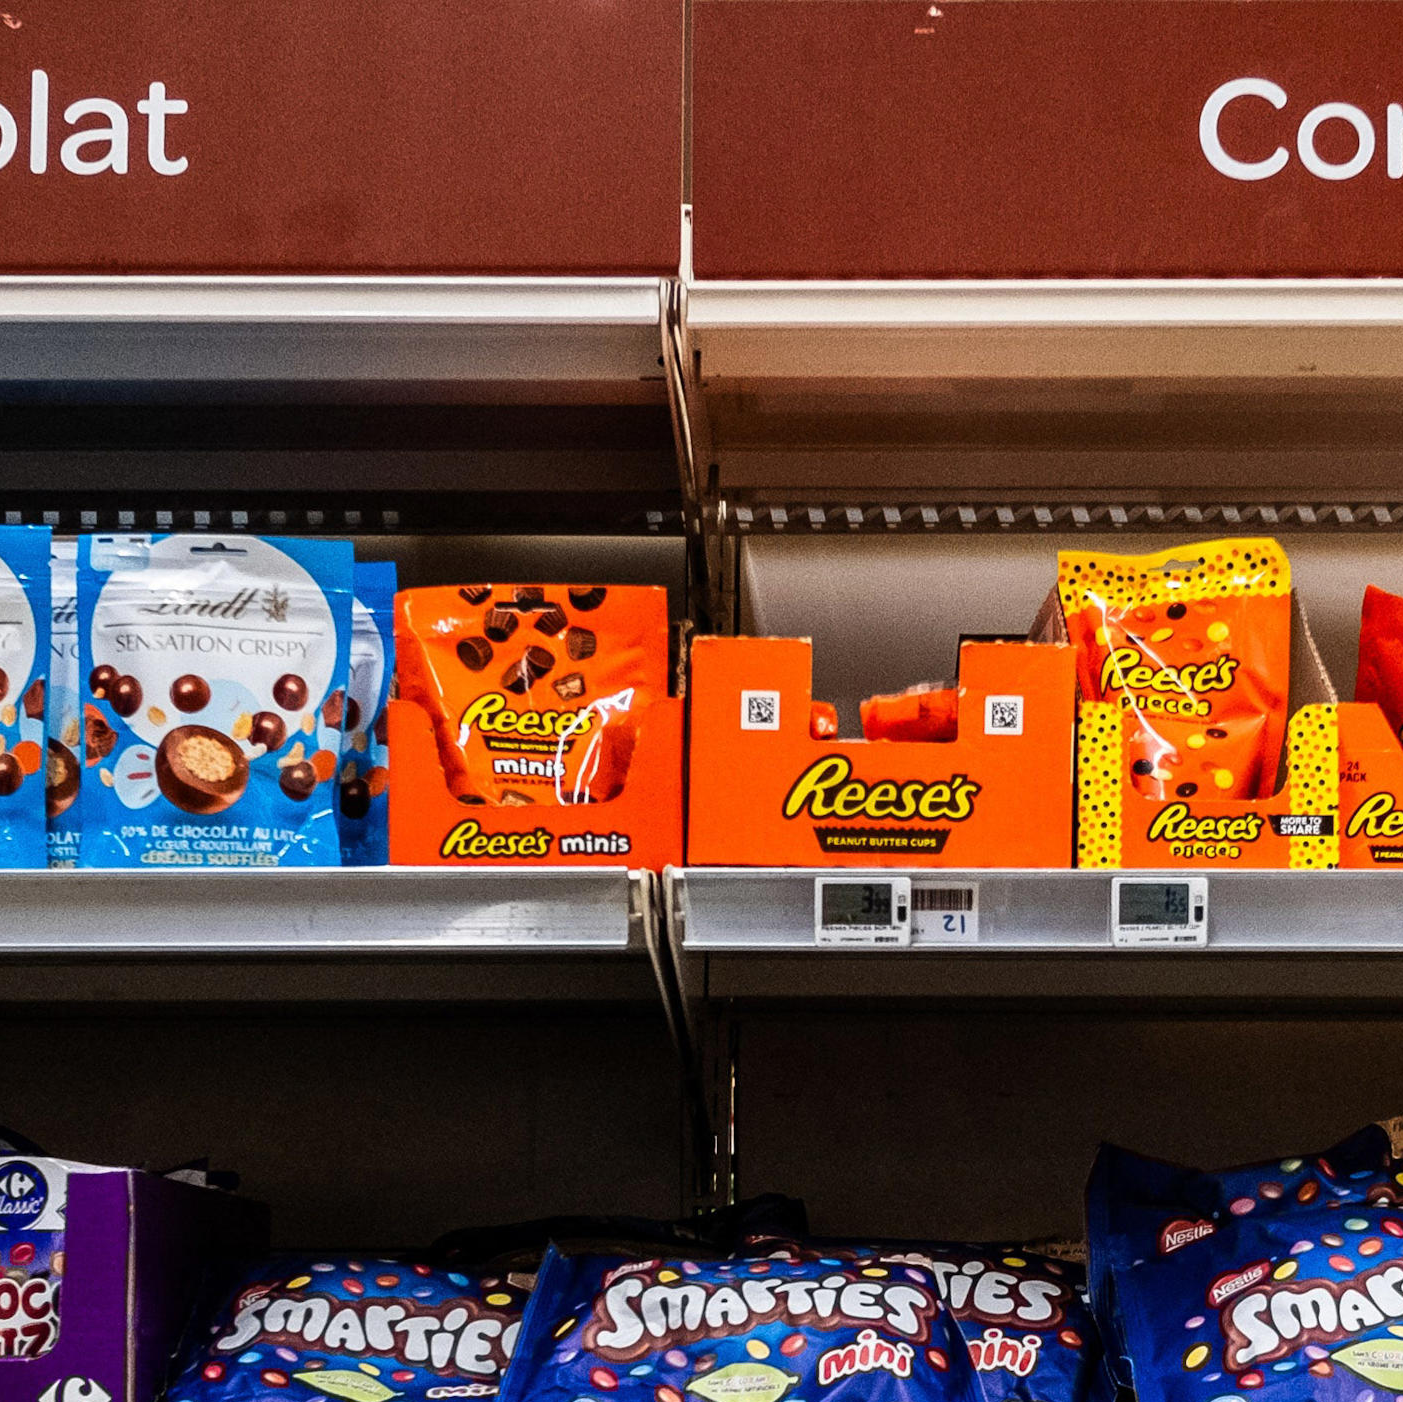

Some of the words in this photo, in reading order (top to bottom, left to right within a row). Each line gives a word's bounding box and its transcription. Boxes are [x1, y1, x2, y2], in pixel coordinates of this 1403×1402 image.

[114, 632, 233, 654] SENSATION
[237, 636, 312, 659] CRISPY
[1101, 648, 1239, 694] Reese's
[459, 693, 596, 738] Reese's
[784, 754, 982, 821] Reese's
[1339, 771, 1368, 784] PACK
[151, 824, 168, 839] DE
[171, 824, 247, 840] CHOCOLAT
[250, 824, 270, 839] AU
[272, 824, 298, 840] LAIT
[1148, 803, 1264, 843] Reese's
[1279, 815, 1309, 827] MORE
[1309, 816, 1323, 827] TO
[1279, 824, 1321, 837] SHARE
[441, 821, 551, 858] Reese's
[559, 832, 630, 855] minis
[826, 834, 866, 849] PEANUT
[869, 835, 907, 848] BUTTER
[910, 835, 937, 849] CUPS
[816, 1330, 914, 1387] mini
